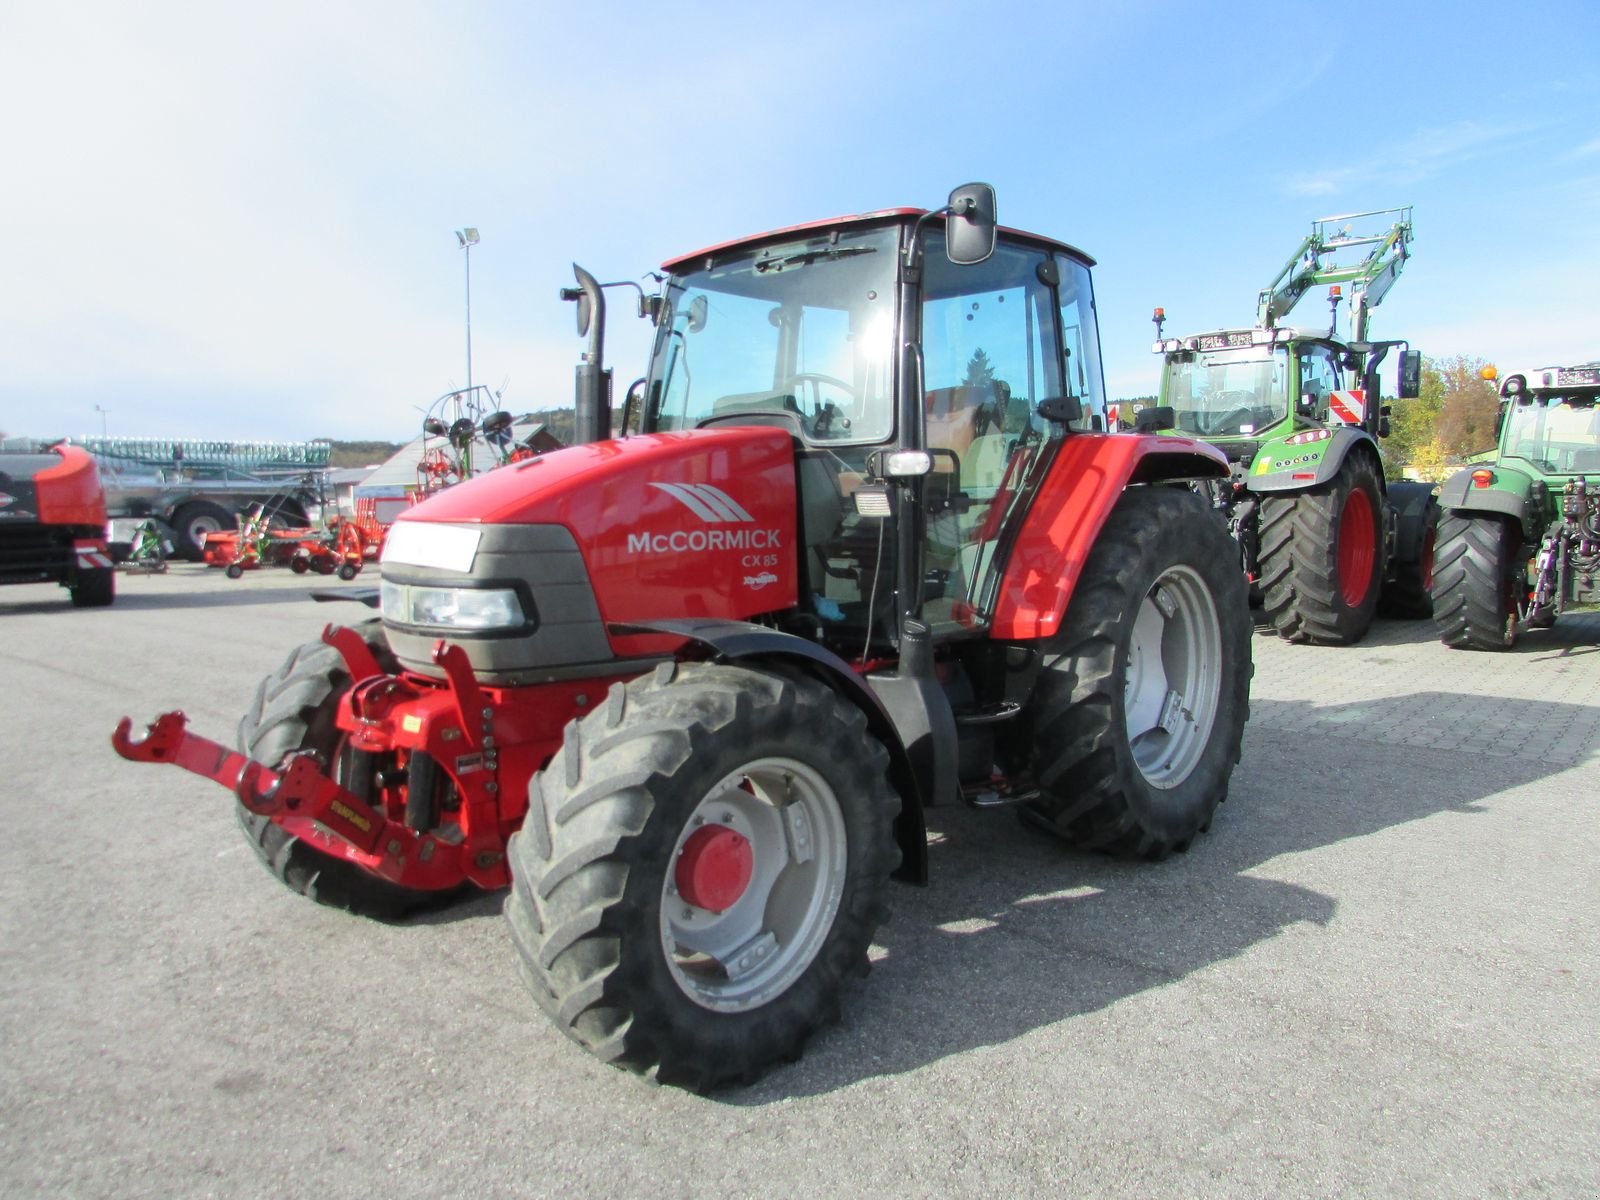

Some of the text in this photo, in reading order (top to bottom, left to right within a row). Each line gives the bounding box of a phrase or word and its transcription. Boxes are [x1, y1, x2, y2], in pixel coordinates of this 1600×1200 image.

[627, 529, 781, 553] McCORMICK
[742, 554, 778, 567] CX 85
